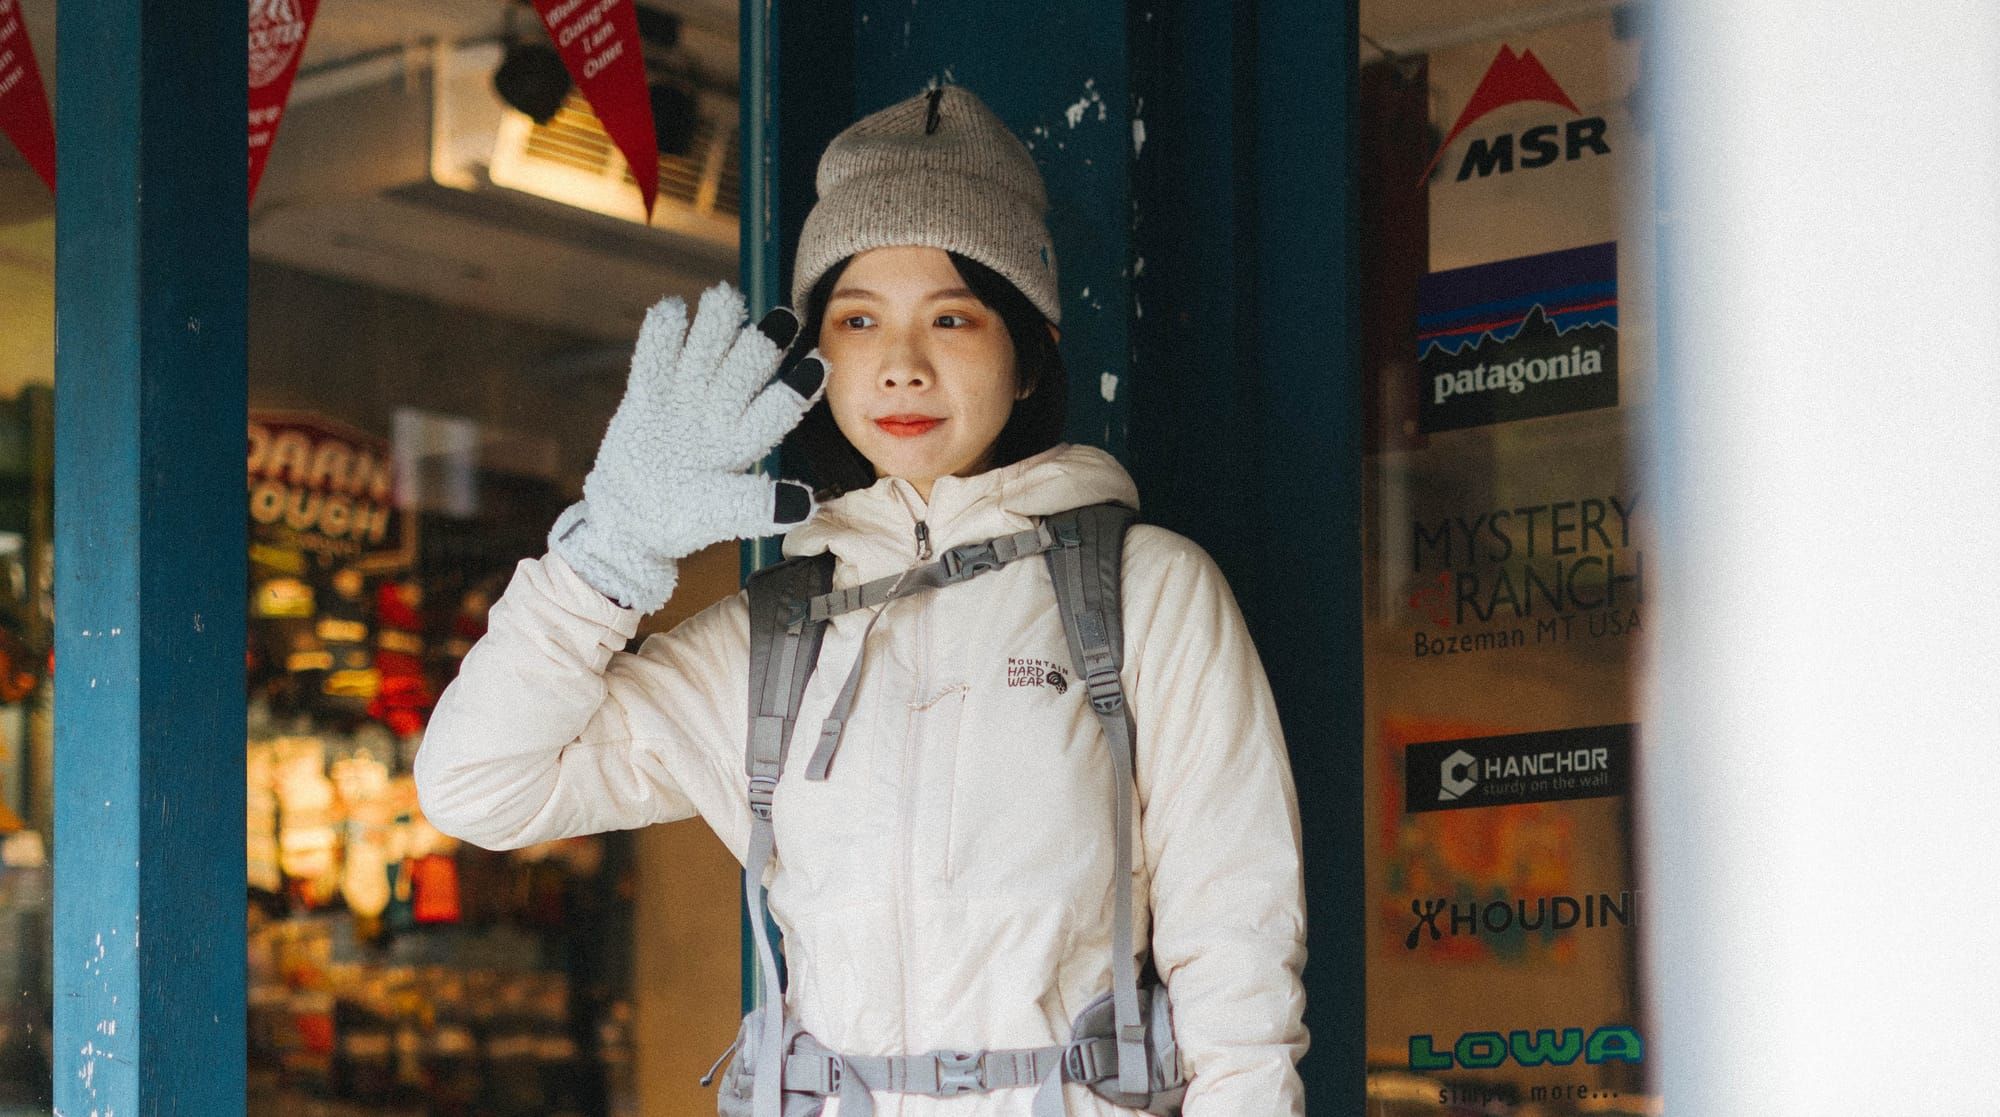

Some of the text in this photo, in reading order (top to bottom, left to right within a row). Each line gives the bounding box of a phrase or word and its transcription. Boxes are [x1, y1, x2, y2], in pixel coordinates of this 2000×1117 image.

[1456, 116, 1612, 183] MSR
[1433, 344, 1603, 405] patagonia
[248, 480, 390, 543] OUGH
[1412, 496, 1641, 573] MYSTERY
[1455, 550, 1644, 626] RANCH
[1414, 607, 1644, 658] Bozeman MT USA
[1008, 658, 1069, 675] MOUNTAIN
[1008, 667, 1044, 677] HARD
[1008, 677, 1045, 688] WEAR
[1483, 771, 1609, 795] sturdy on the wall
[1485, 747, 1608, 780] HANCHOR
[1409, 1026, 1643, 1071] LOWA
